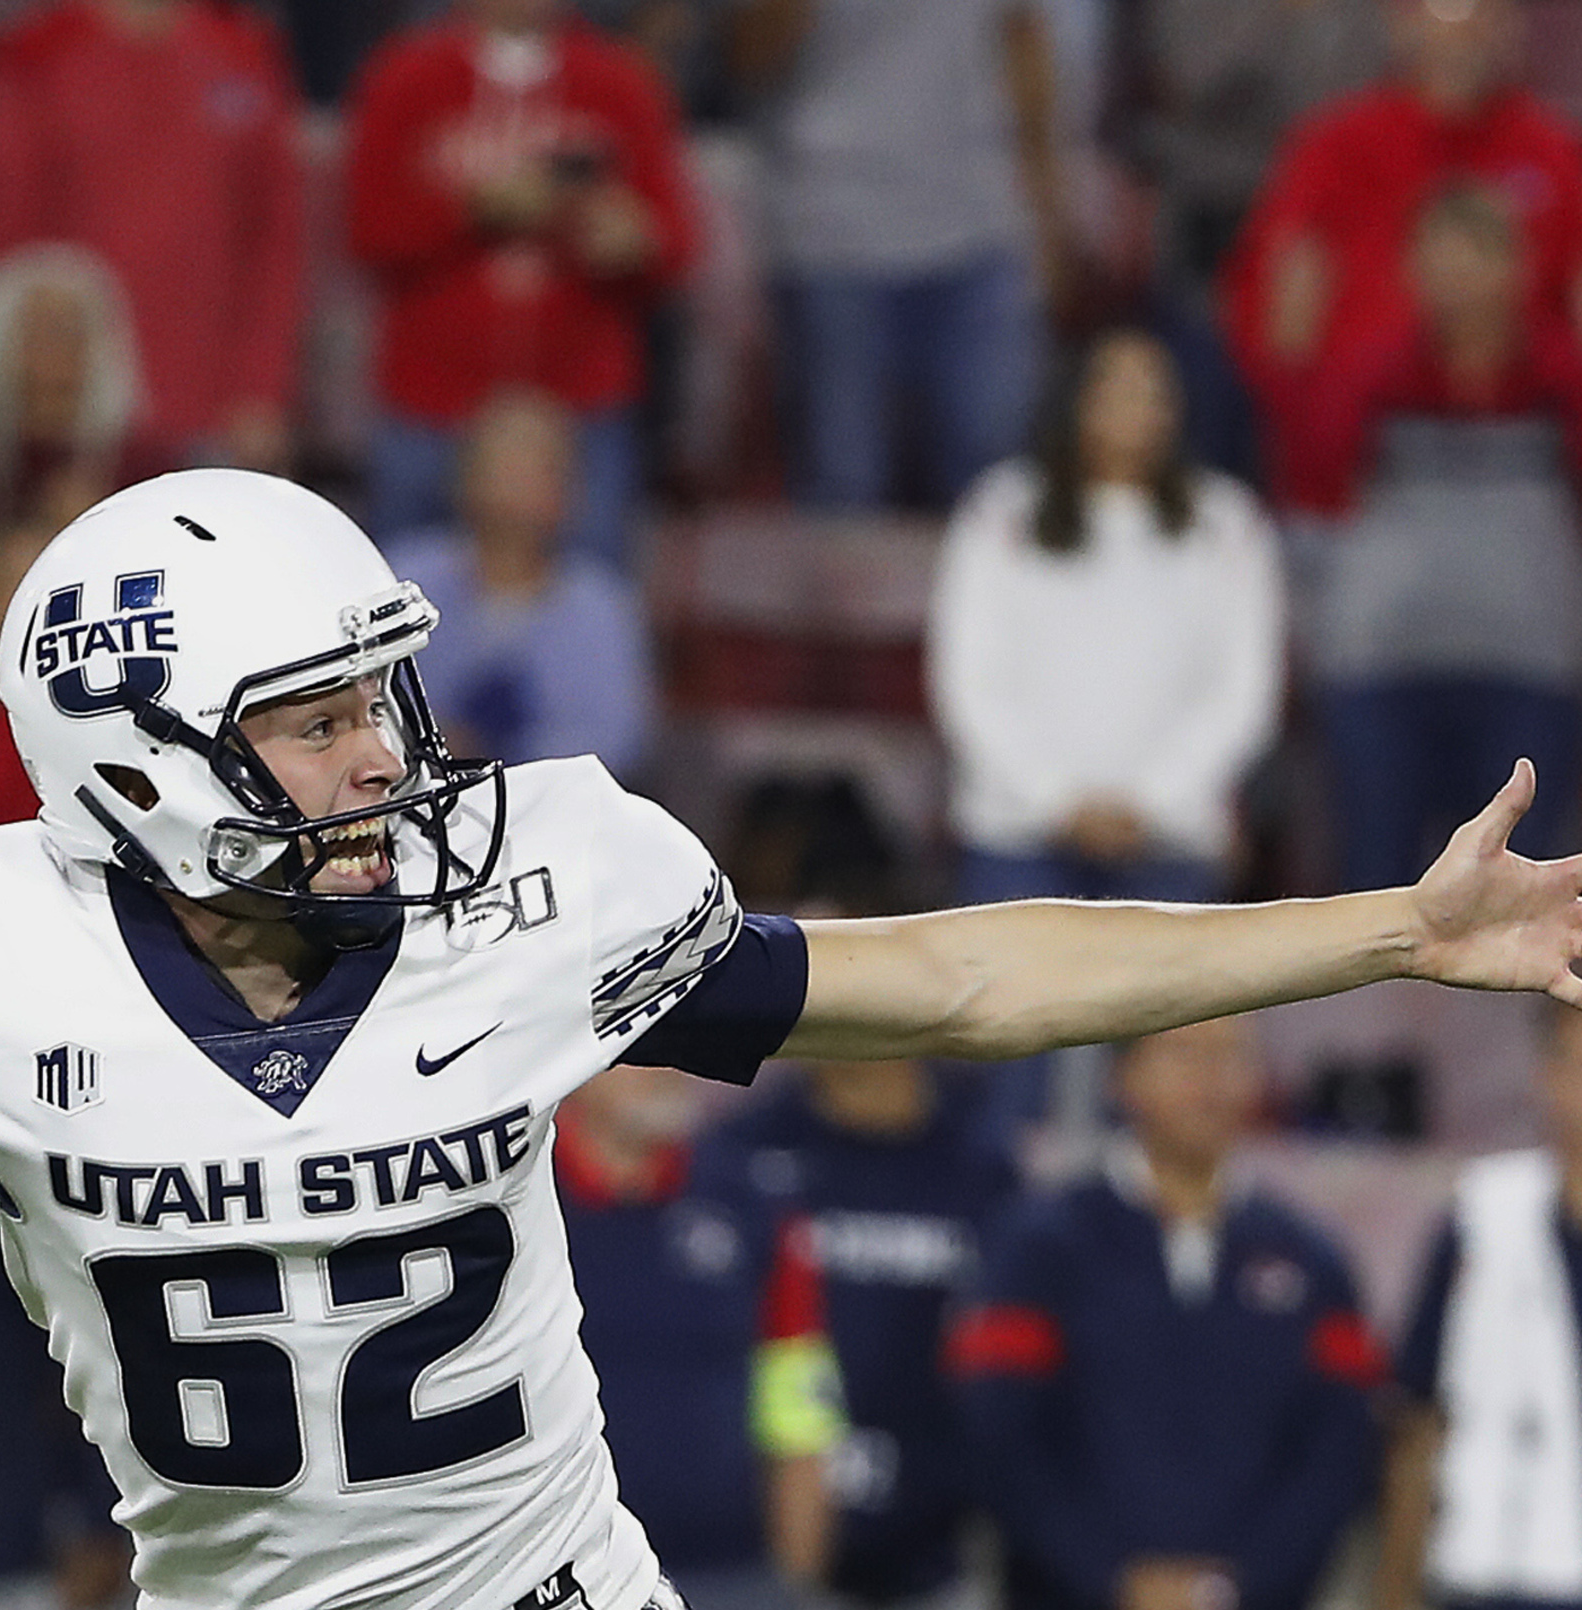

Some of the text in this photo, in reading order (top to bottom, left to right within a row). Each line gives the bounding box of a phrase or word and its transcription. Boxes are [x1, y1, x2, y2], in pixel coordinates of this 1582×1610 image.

[35, 610, 179, 679] STATE
[44, 1100, 534, 1227] UTAH STATE
[82, 1202, 535, 1498] 62
[536, 1575, 561, 1606] M
